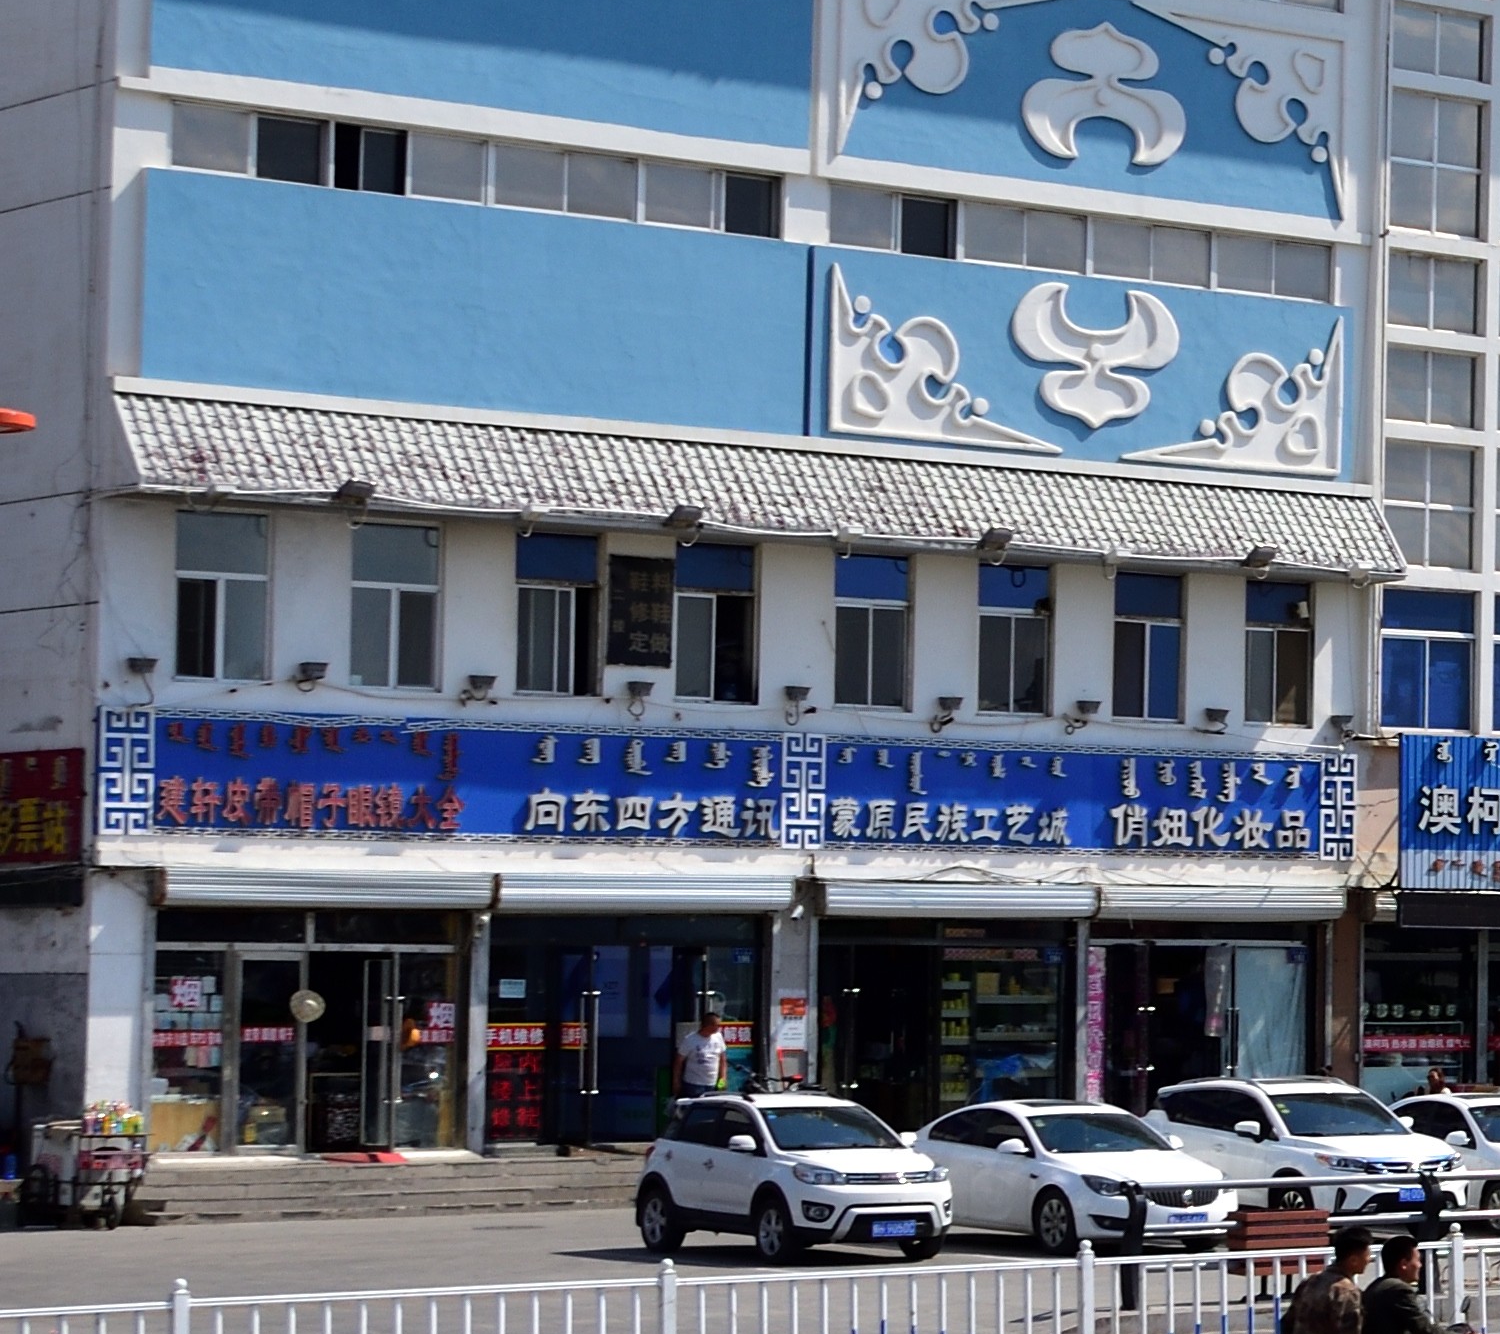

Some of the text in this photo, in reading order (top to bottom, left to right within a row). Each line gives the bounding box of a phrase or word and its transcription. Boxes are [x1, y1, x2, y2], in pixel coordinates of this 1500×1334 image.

[629, 632, 672, 653] 定做
[156, 775, 465, 831] 建轩皮带帽子眼镜大全
[523, 787, 781, 840] 向东四方通讯
[829, 796, 1073, 847] 蒙原民族工艺城
[1111, 802, 1312, 850] 俏妞化妆品
